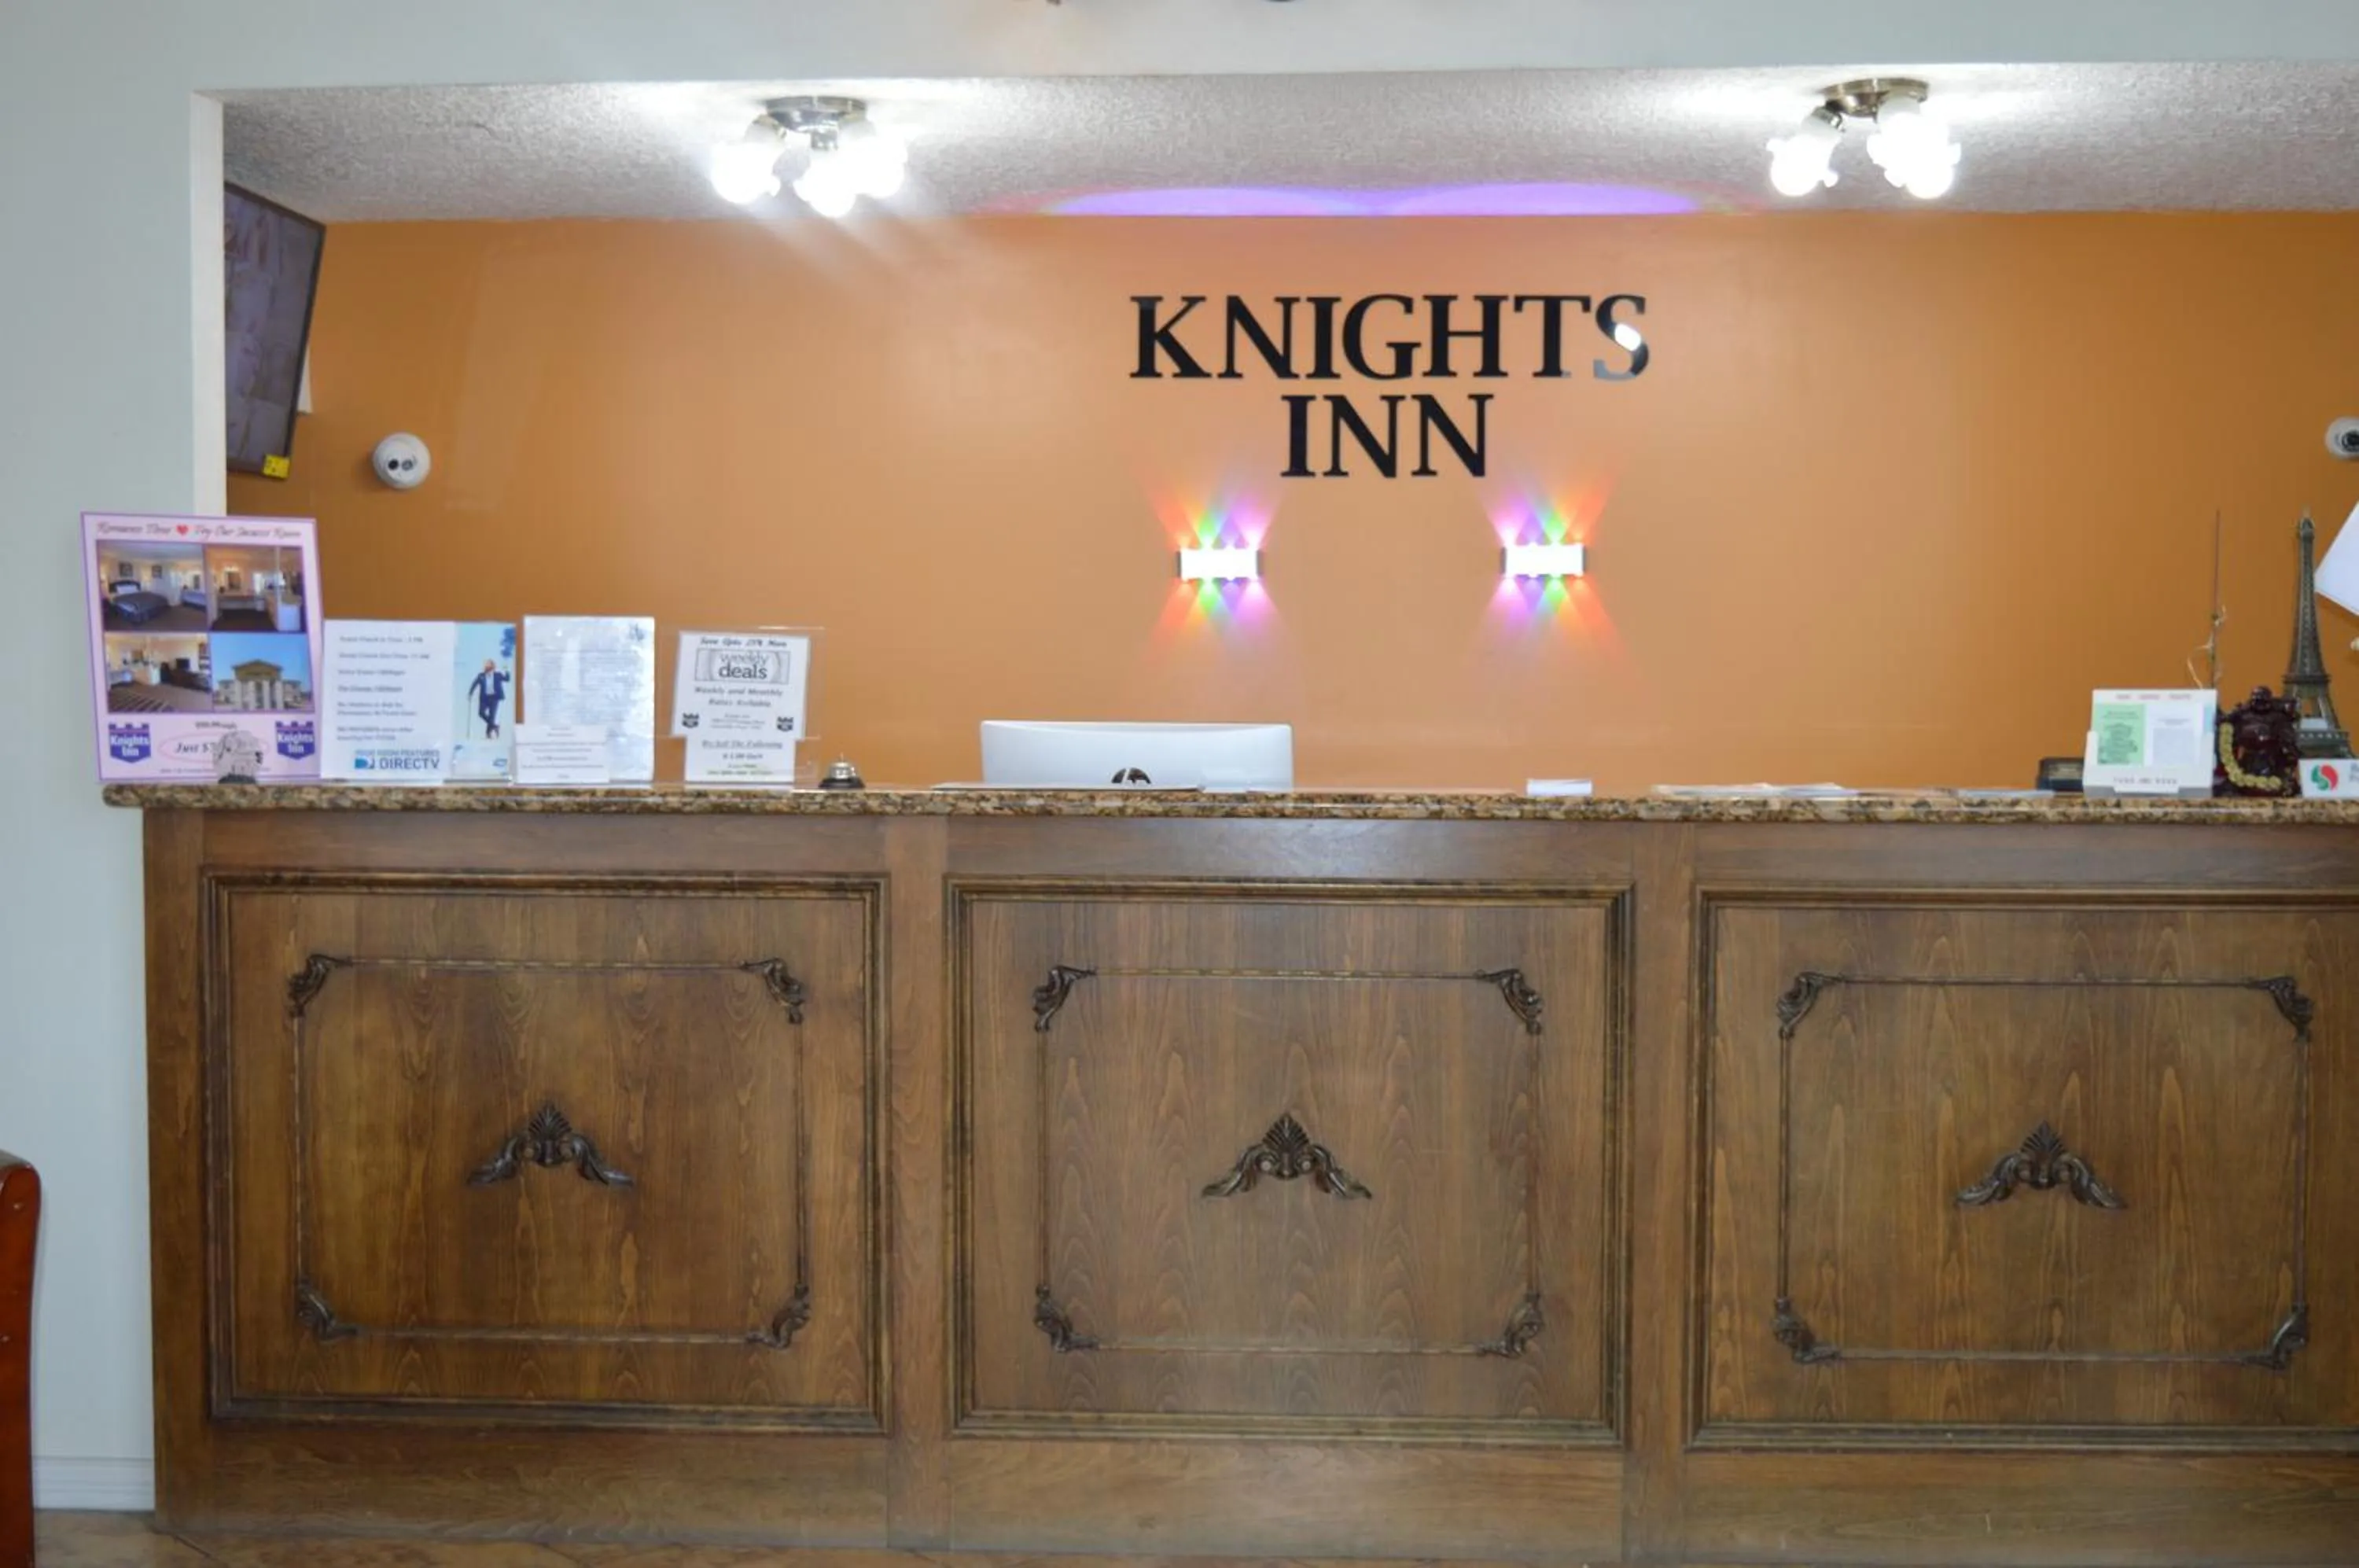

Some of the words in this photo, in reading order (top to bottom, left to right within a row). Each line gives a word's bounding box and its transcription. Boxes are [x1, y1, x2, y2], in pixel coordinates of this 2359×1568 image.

[1129, 294, 1650, 381] KNIGHTS
[1281, 394, 1493, 477] INN
[719, 650, 770, 667] weekly
[718, 661, 767, 679] deals
[110, 734, 150, 747] Knights
[277, 732, 315, 745] Knights
[122, 745, 140, 756] Inn
[286, 743, 305, 754] Inn
[379, 757, 440, 770] DIRECTV
